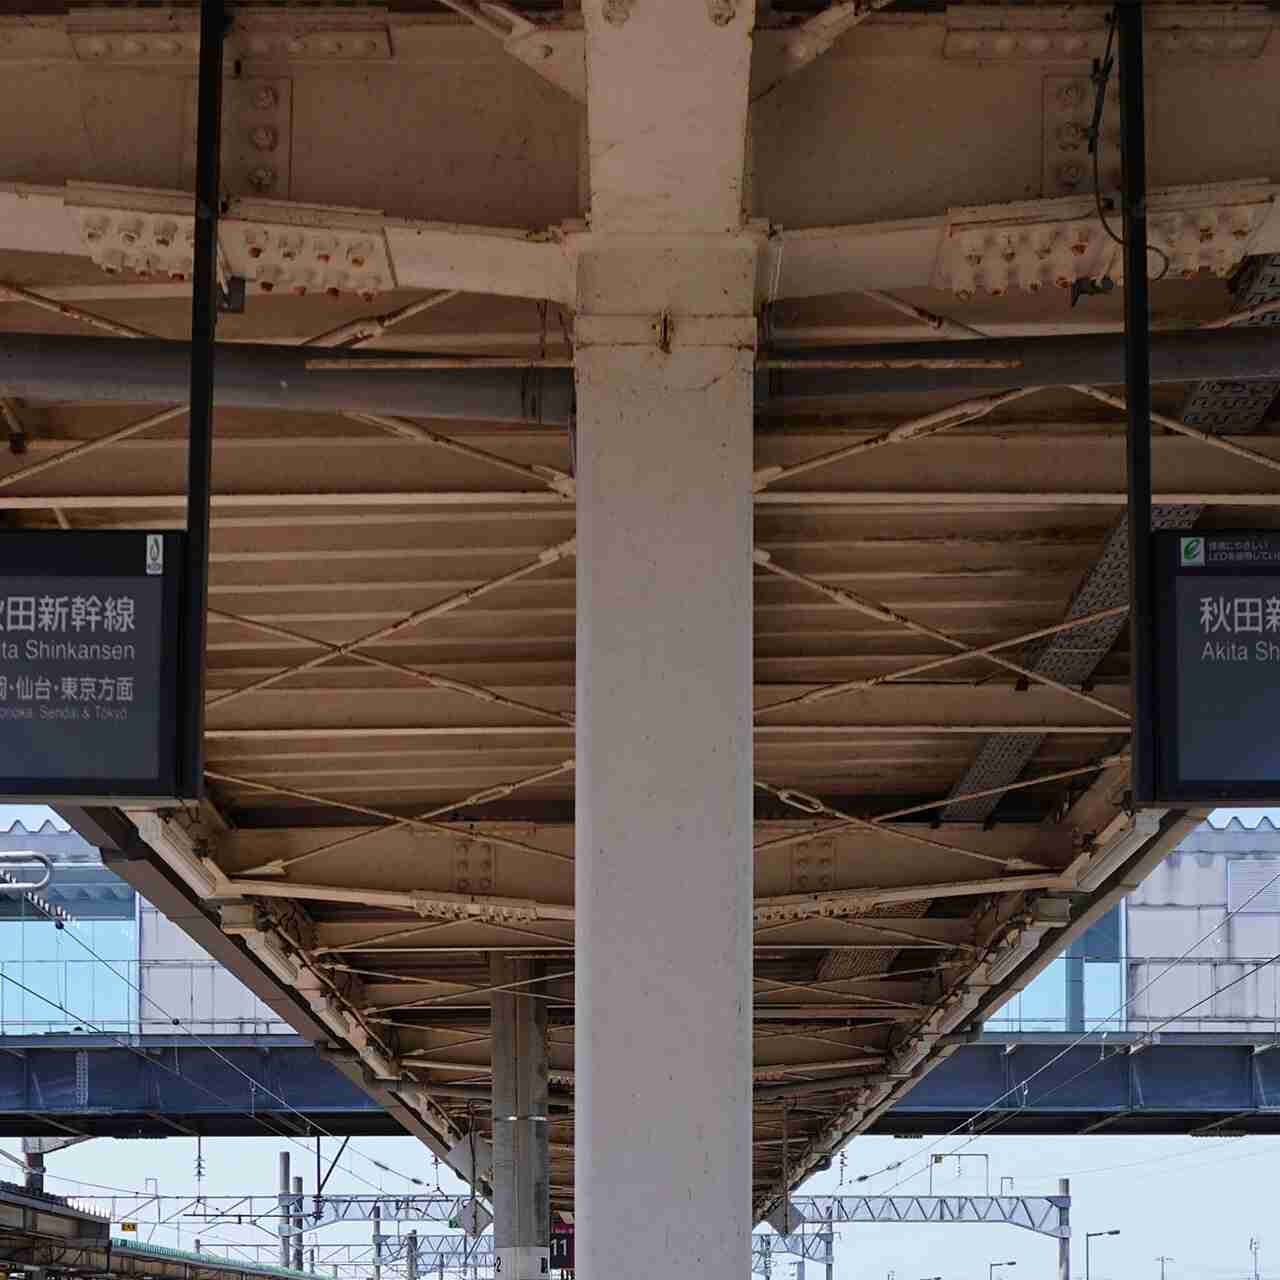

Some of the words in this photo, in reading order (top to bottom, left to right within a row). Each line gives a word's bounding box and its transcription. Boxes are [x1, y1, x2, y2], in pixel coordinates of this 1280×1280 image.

[25, 639, 136, 660] Shinkansen
[1201, 640, 1249, 661] Akita
[550, 1239, 567, 1257] 11
